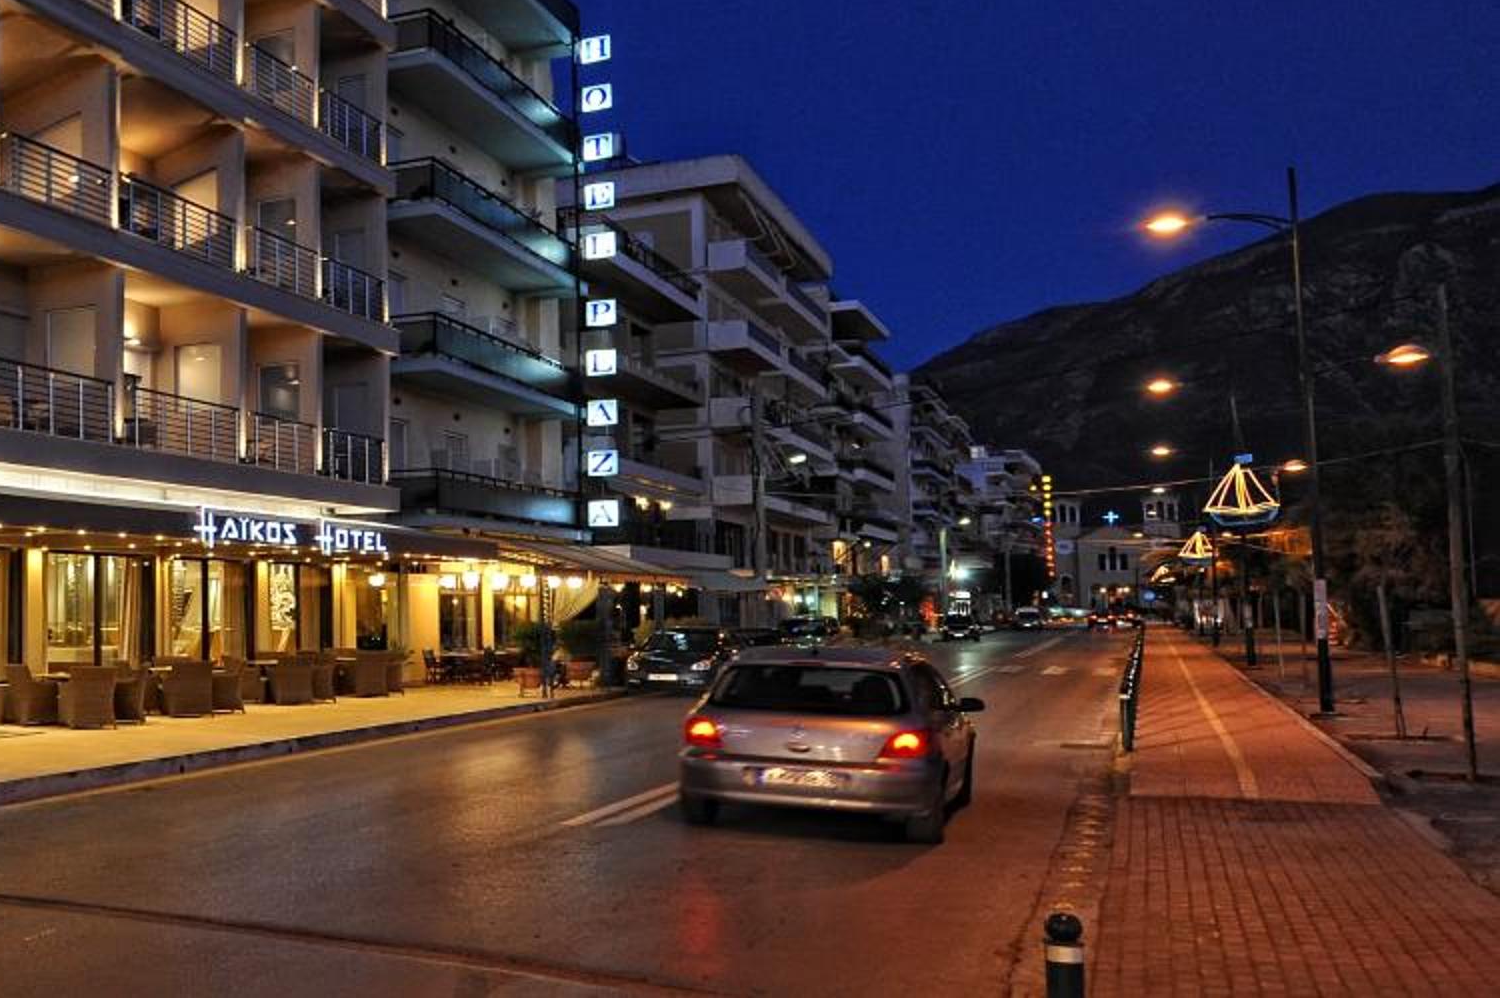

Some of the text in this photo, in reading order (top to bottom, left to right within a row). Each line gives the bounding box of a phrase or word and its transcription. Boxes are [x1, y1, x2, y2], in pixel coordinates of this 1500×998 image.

[583, 36, 616, 524] HOTEL PLAZA
[194, 505, 387, 556] HAÏKOS HOTEL
